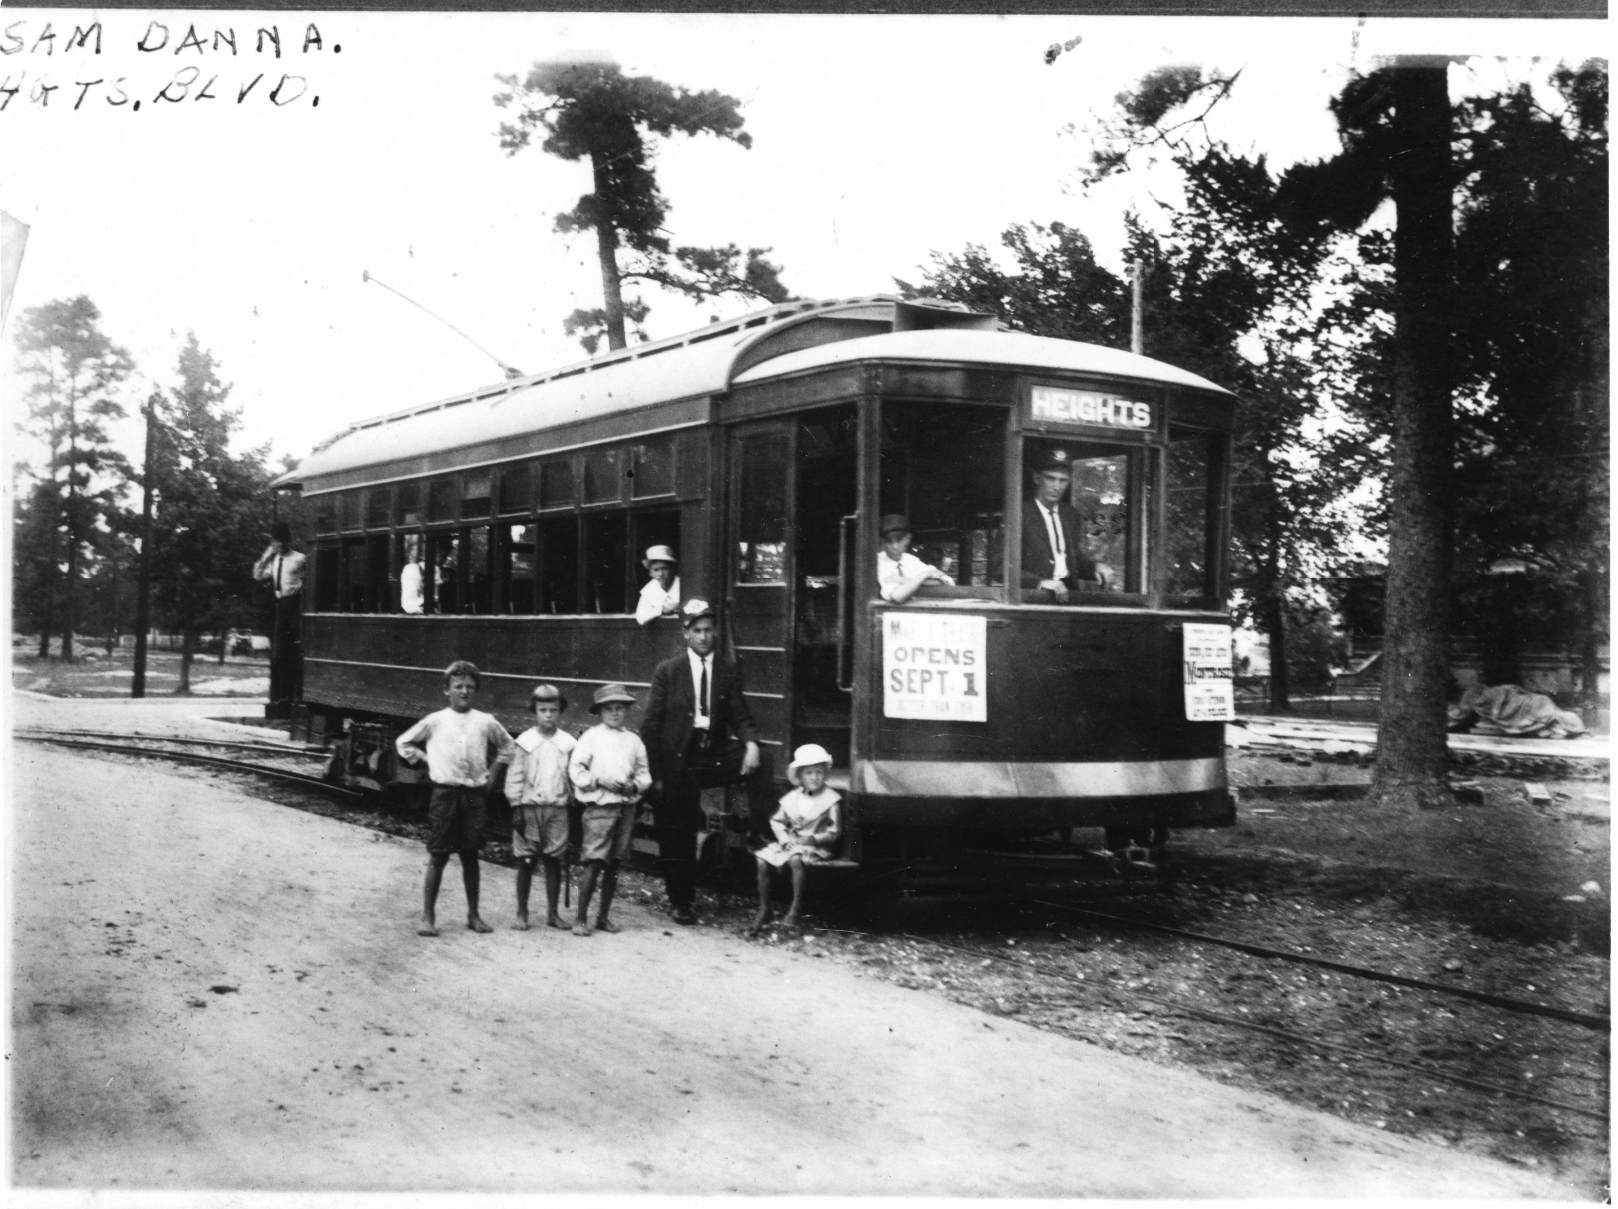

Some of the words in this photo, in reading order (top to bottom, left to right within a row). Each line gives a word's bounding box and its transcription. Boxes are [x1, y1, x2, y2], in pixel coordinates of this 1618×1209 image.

[0, 20, 102, 55] SAM
[153, 66, 320, 107] BLVD.
[1031, 390, 1151, 427] HEIGHTS
[894, 646, 975, 666] OPENS
[963, 672, 979, 697] 1
